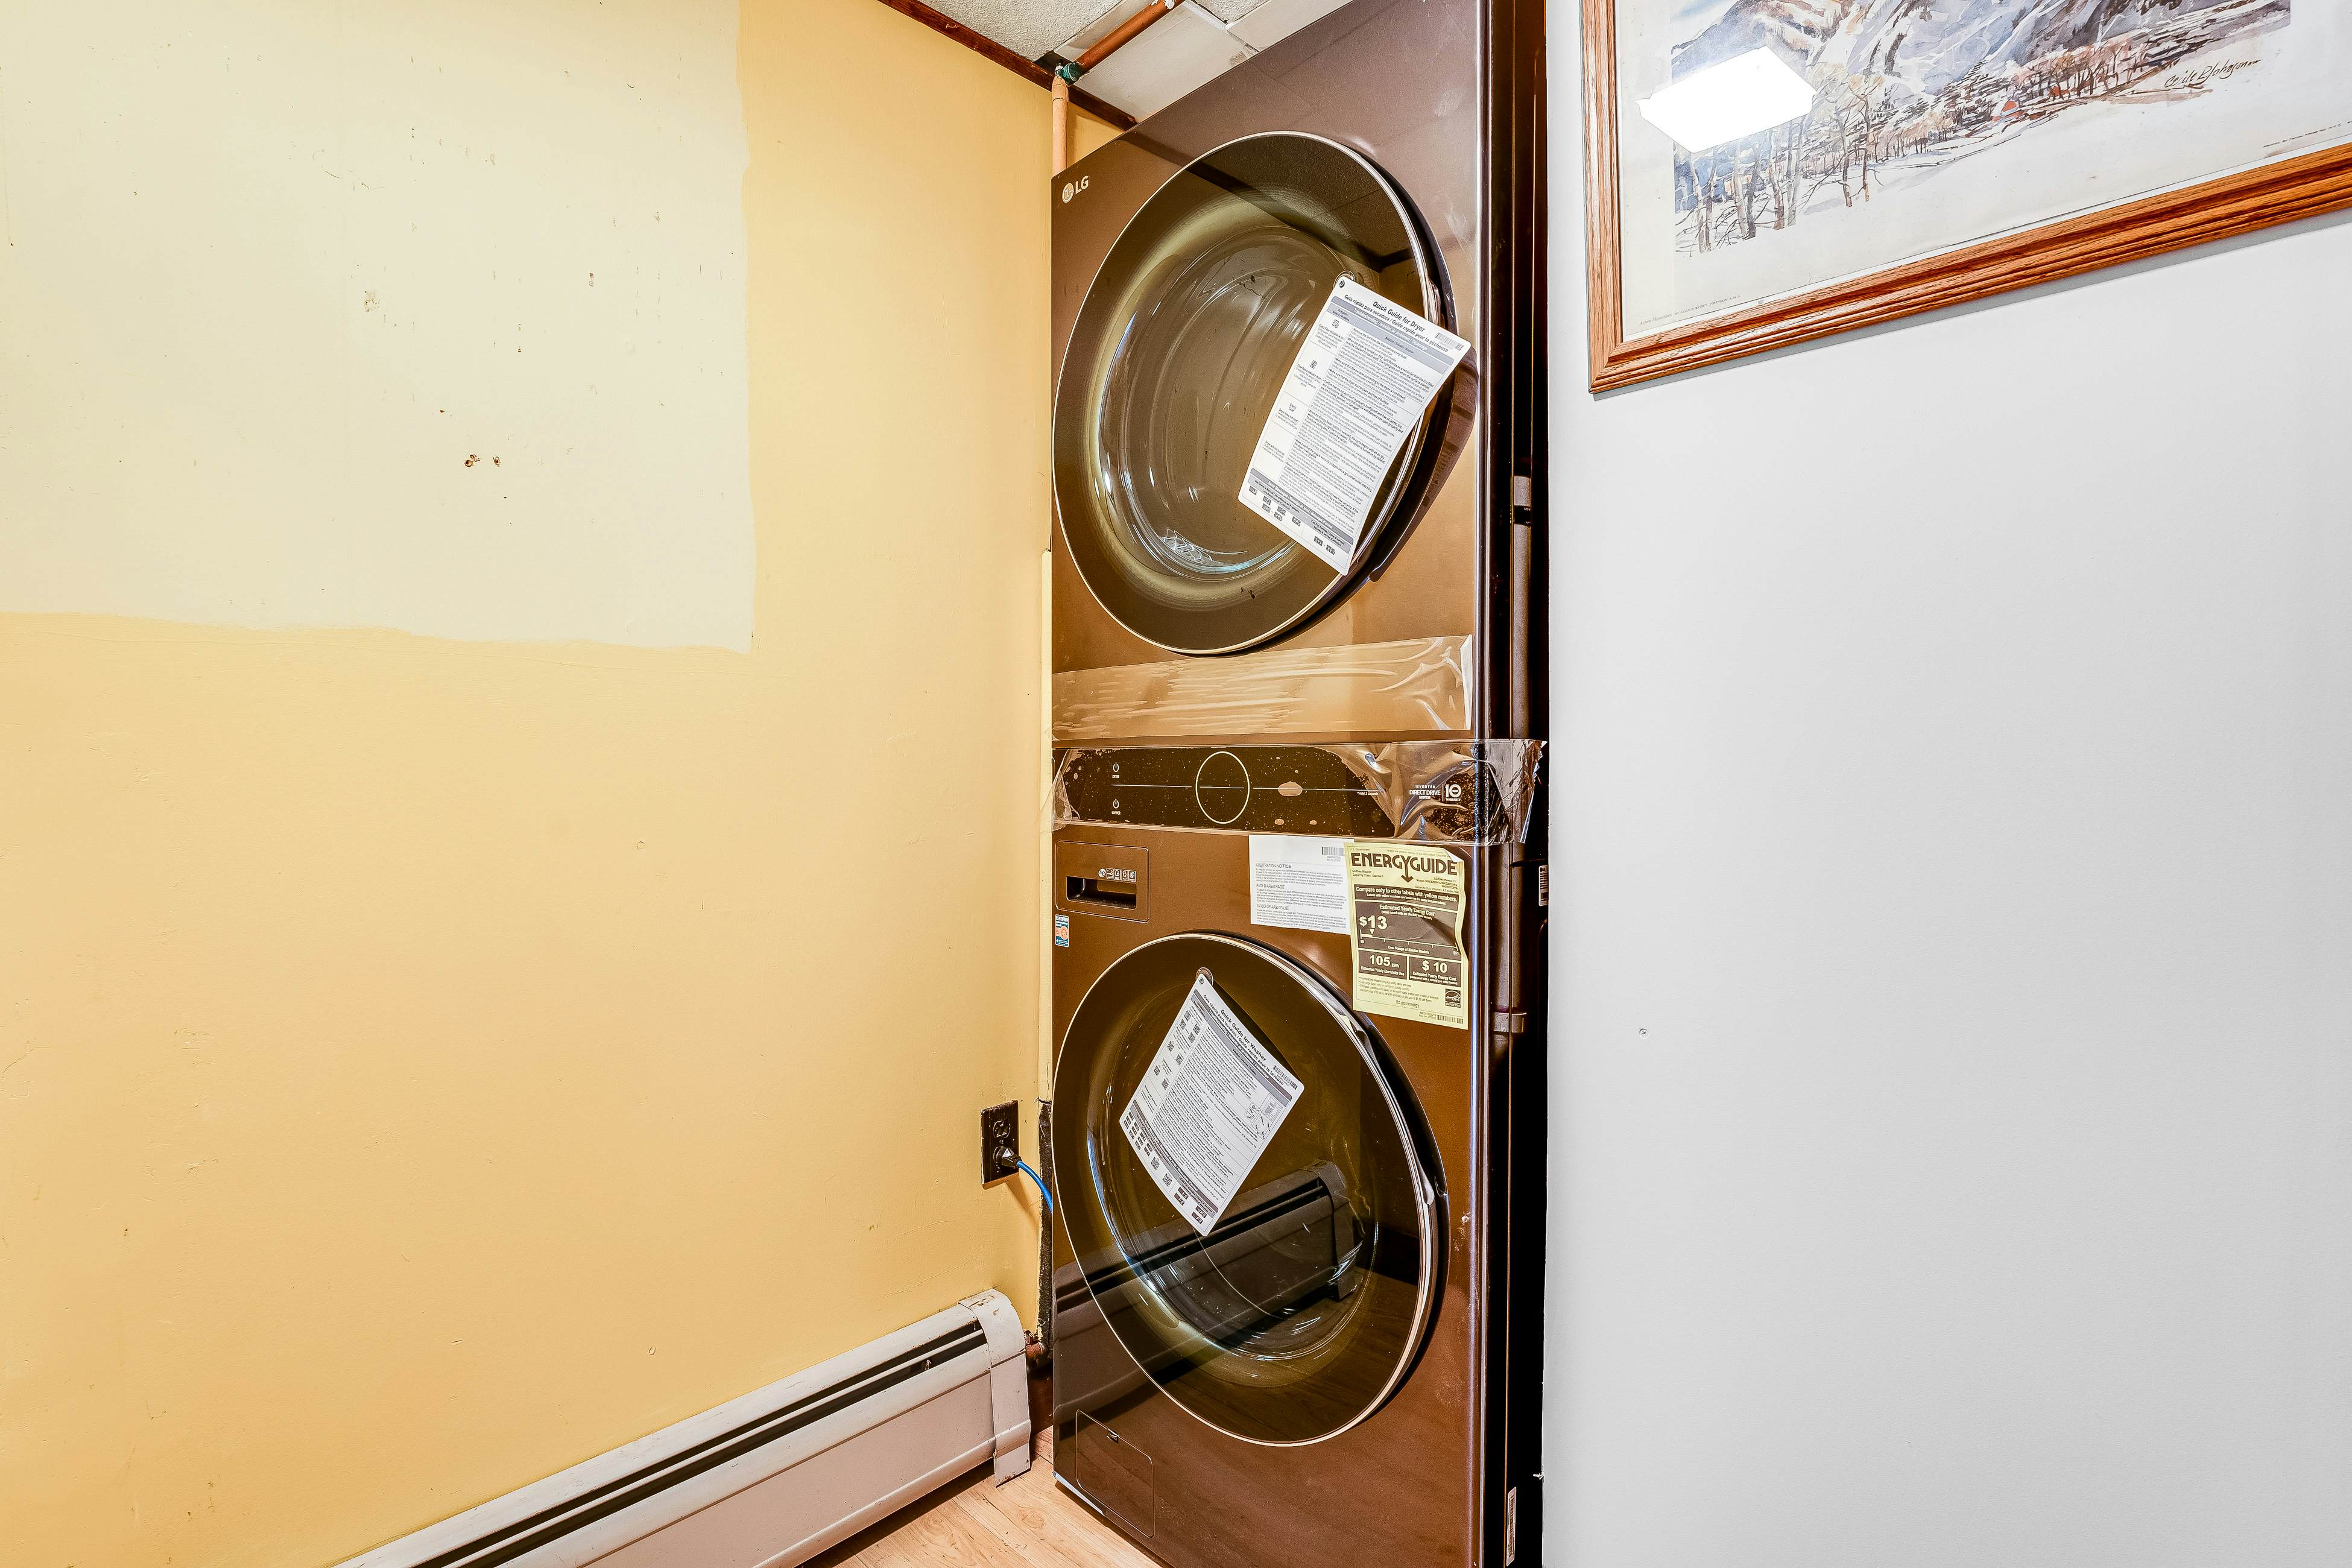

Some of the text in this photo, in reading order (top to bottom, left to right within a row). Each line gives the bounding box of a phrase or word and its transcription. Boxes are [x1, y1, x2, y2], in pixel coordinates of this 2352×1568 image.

[1075, 175, 1089, 194] LG
[1372, 309, 1390, 321] secadora
[1391, 319, 1403, 328] Guide
[1402, 325, 1415, 336] rapide
[1414, 332, 1425, 341] pour
[1373, 300, 1387, 312] Quick
[1387, 308, 1402, 320] Guide
[1409, 321, 1426, 334] Dryer
[1445, 784, 1462, 798] 10
[1351, 852, 1457, 880] ENERGYGUIDE
[1359, 915, 1388, 929] $13
[1369, 955, 1391, 967] 105
[1422, 959, 1447, 973] $ 10
[1220, 1008, 1232, 1023] Quick
[1231, 1022, 1244, 1037] Guide
[1250, 1042, 1266, 1062] Washer
